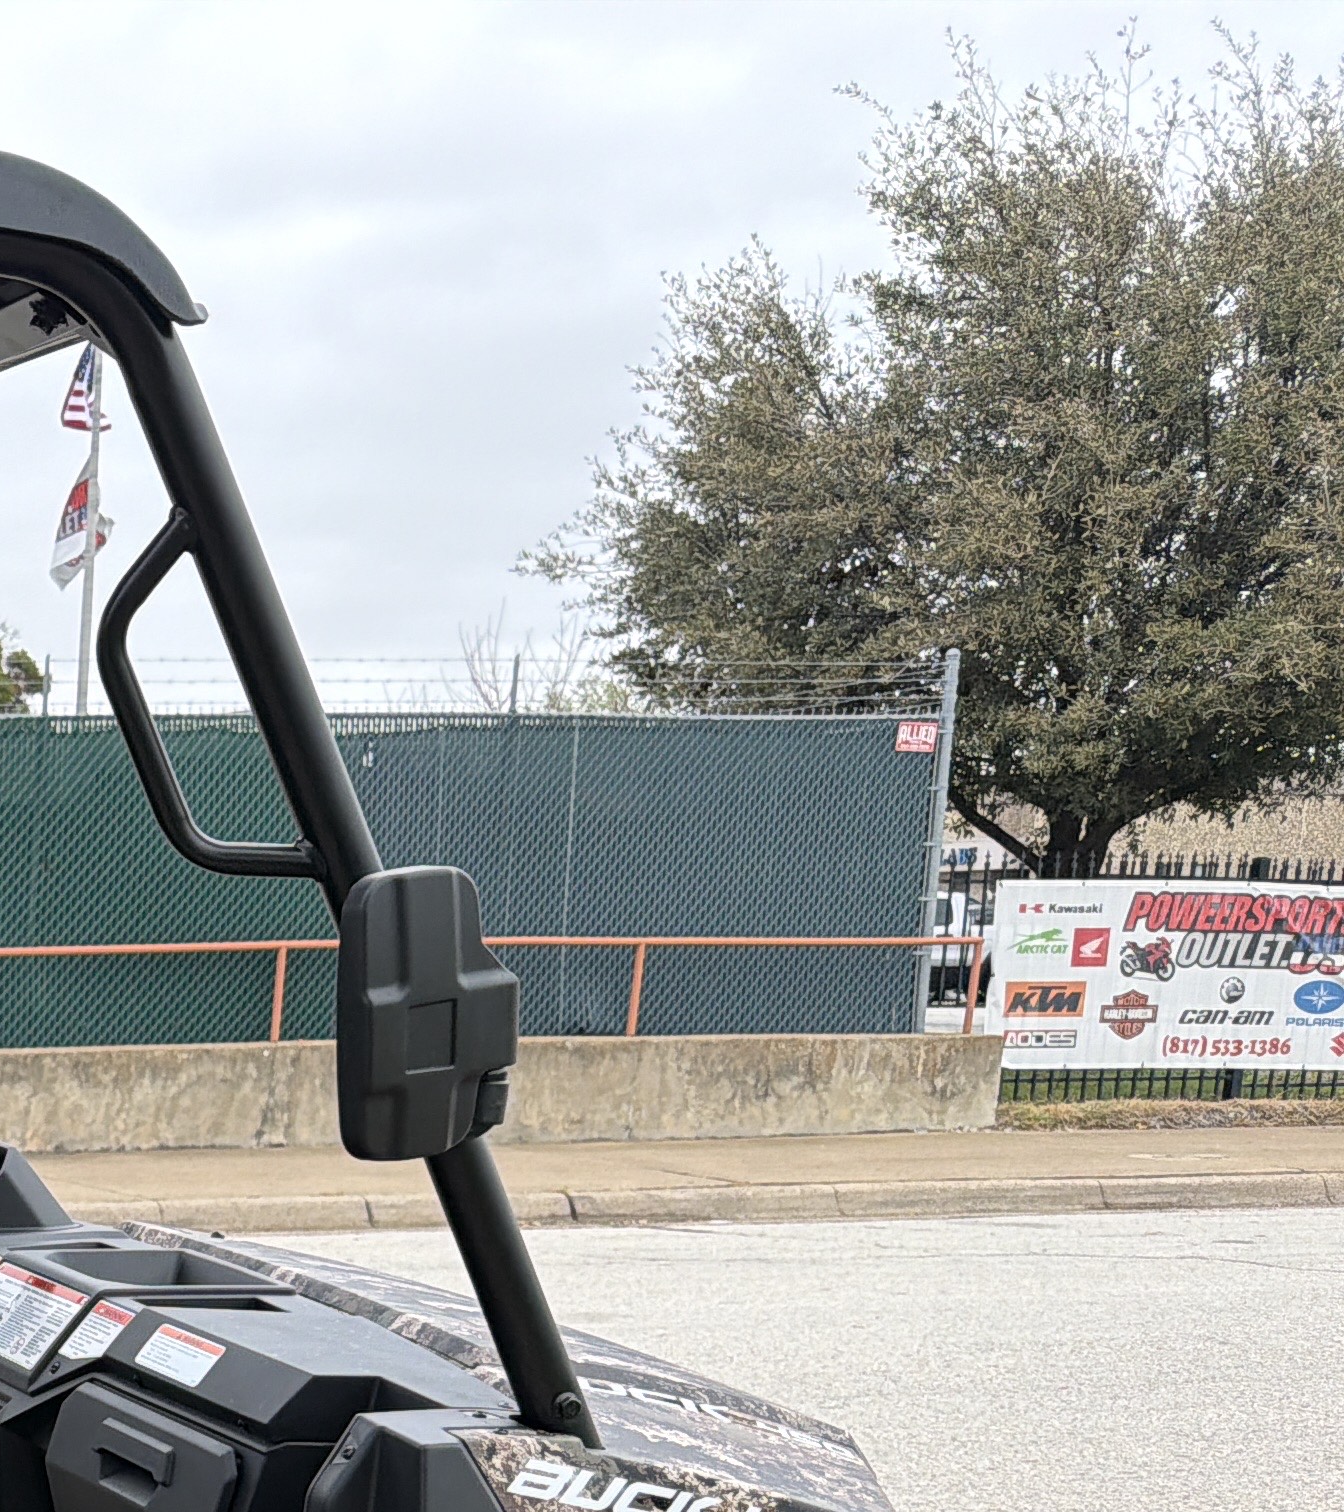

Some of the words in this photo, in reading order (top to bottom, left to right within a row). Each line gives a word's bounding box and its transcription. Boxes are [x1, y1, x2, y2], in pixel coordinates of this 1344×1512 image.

[1049, 903, 1104, 914] Kawasaki
[1123, 891, 1344, 934] POWEERSPORT
[1007, 985, 1083, 1013] KTM
[1178, 1009, 1275, 1026] can-am
[1285, 1017, 1344, 1028] POLARIS
[1162, 1035, 1208, 1058] (817)
[1210, 1037, 1292, 1058] 533-1386
